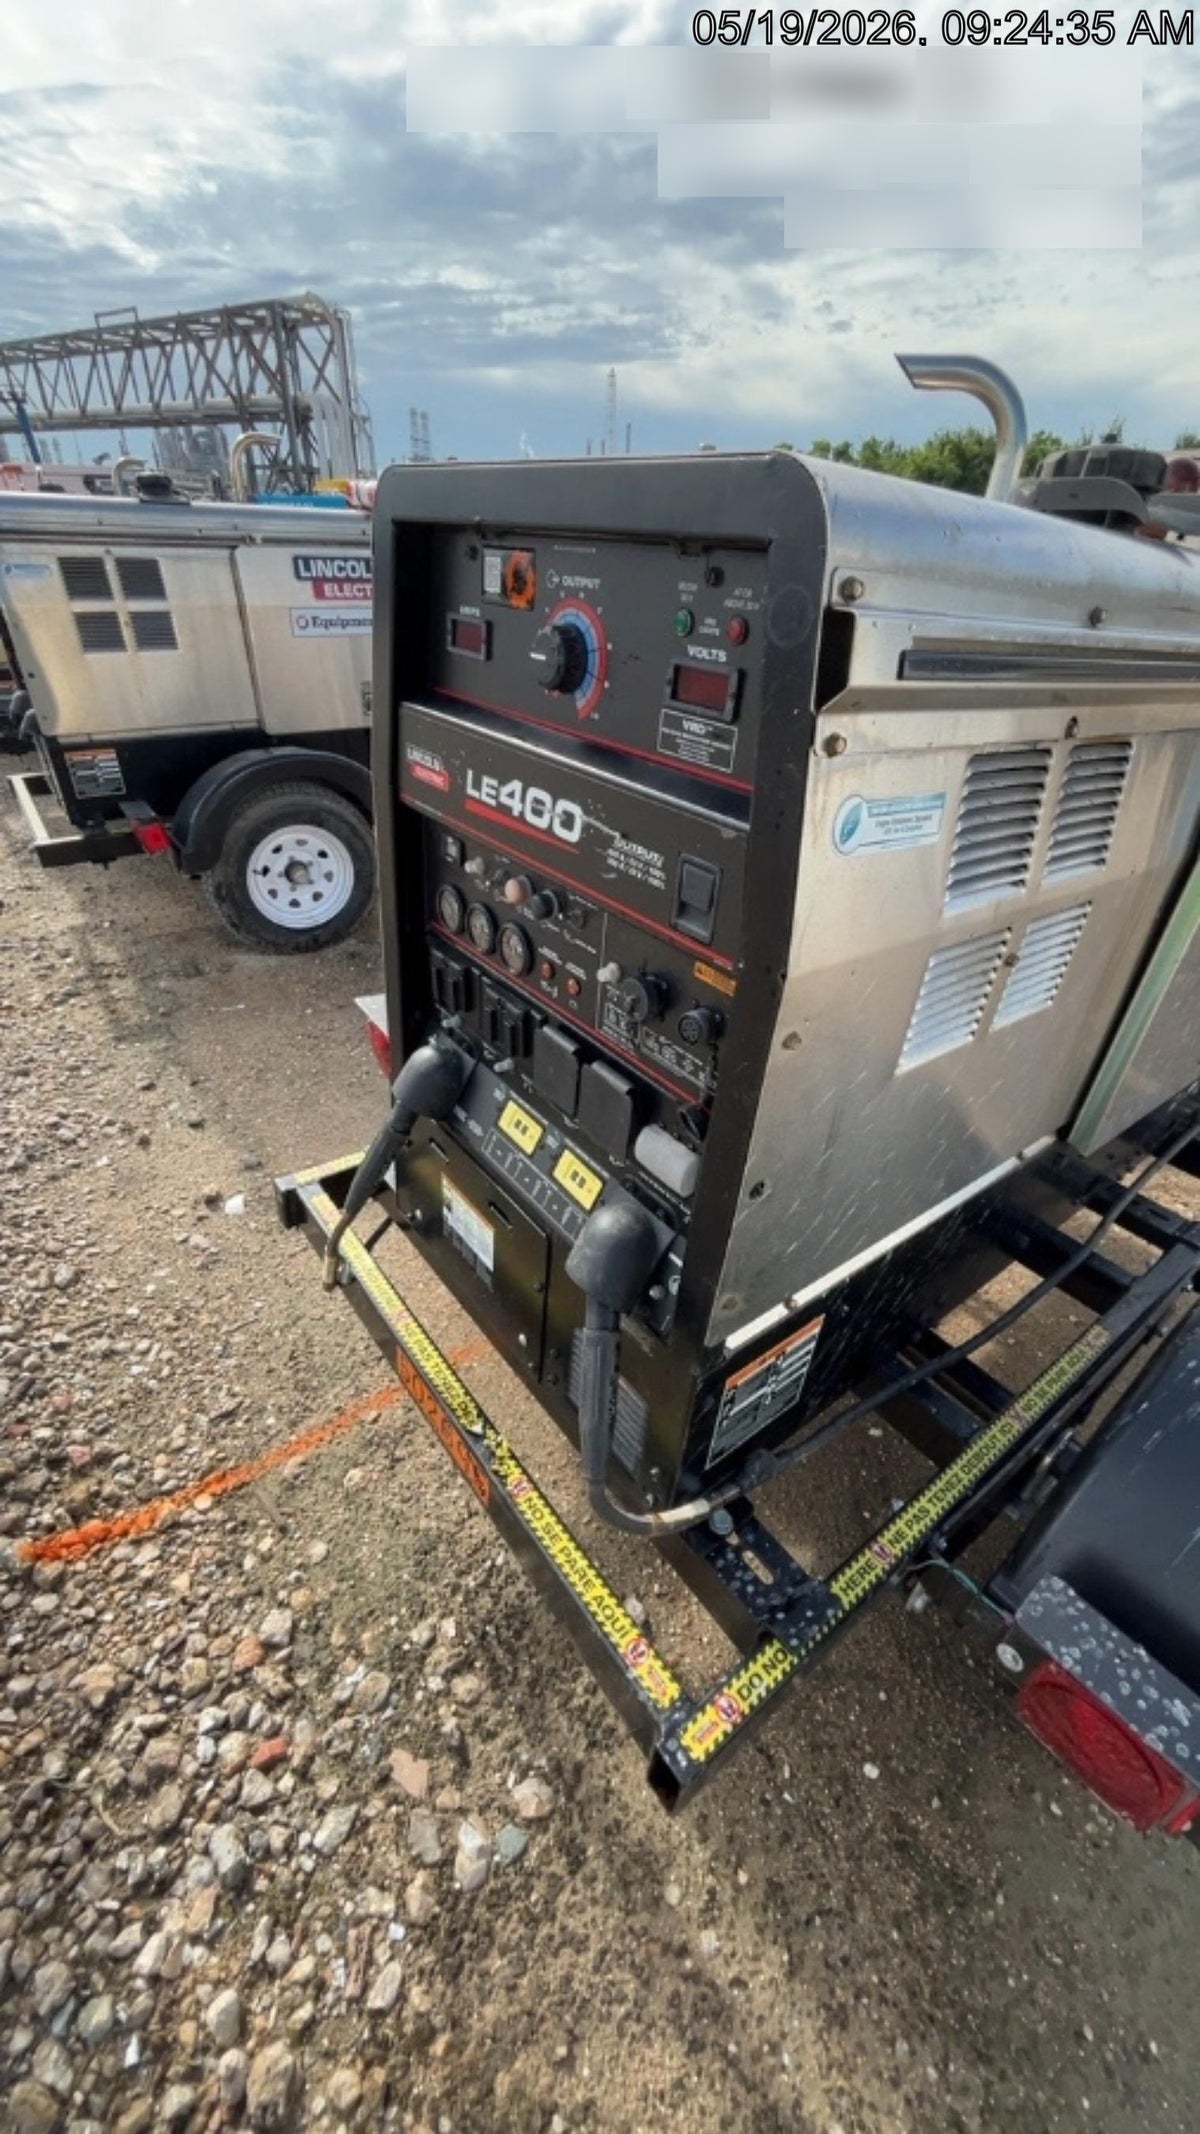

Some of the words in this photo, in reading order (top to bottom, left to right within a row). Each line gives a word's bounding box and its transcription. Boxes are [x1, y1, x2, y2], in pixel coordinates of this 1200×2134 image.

[297, 559, 373, 578] LINCOL
[562, 575, 600, 589] OUTPUT
[687, 644, 727, 662] VOLTS
[466, 767, 582, 843] LE400
[886, 1528, 907, 1549] NE
[902, 1505, 930, 1533] PAS
[958, 1431, 1004, 1476] DEBOUT
[522, 1497, 545, 1522] NO
[540, 1521, 562, 1546] SE
[557, 1544, 596, 1593] PARE
[838, 1557, 878, 1597] HERE
[735, 1670, 766, 1702] DO
